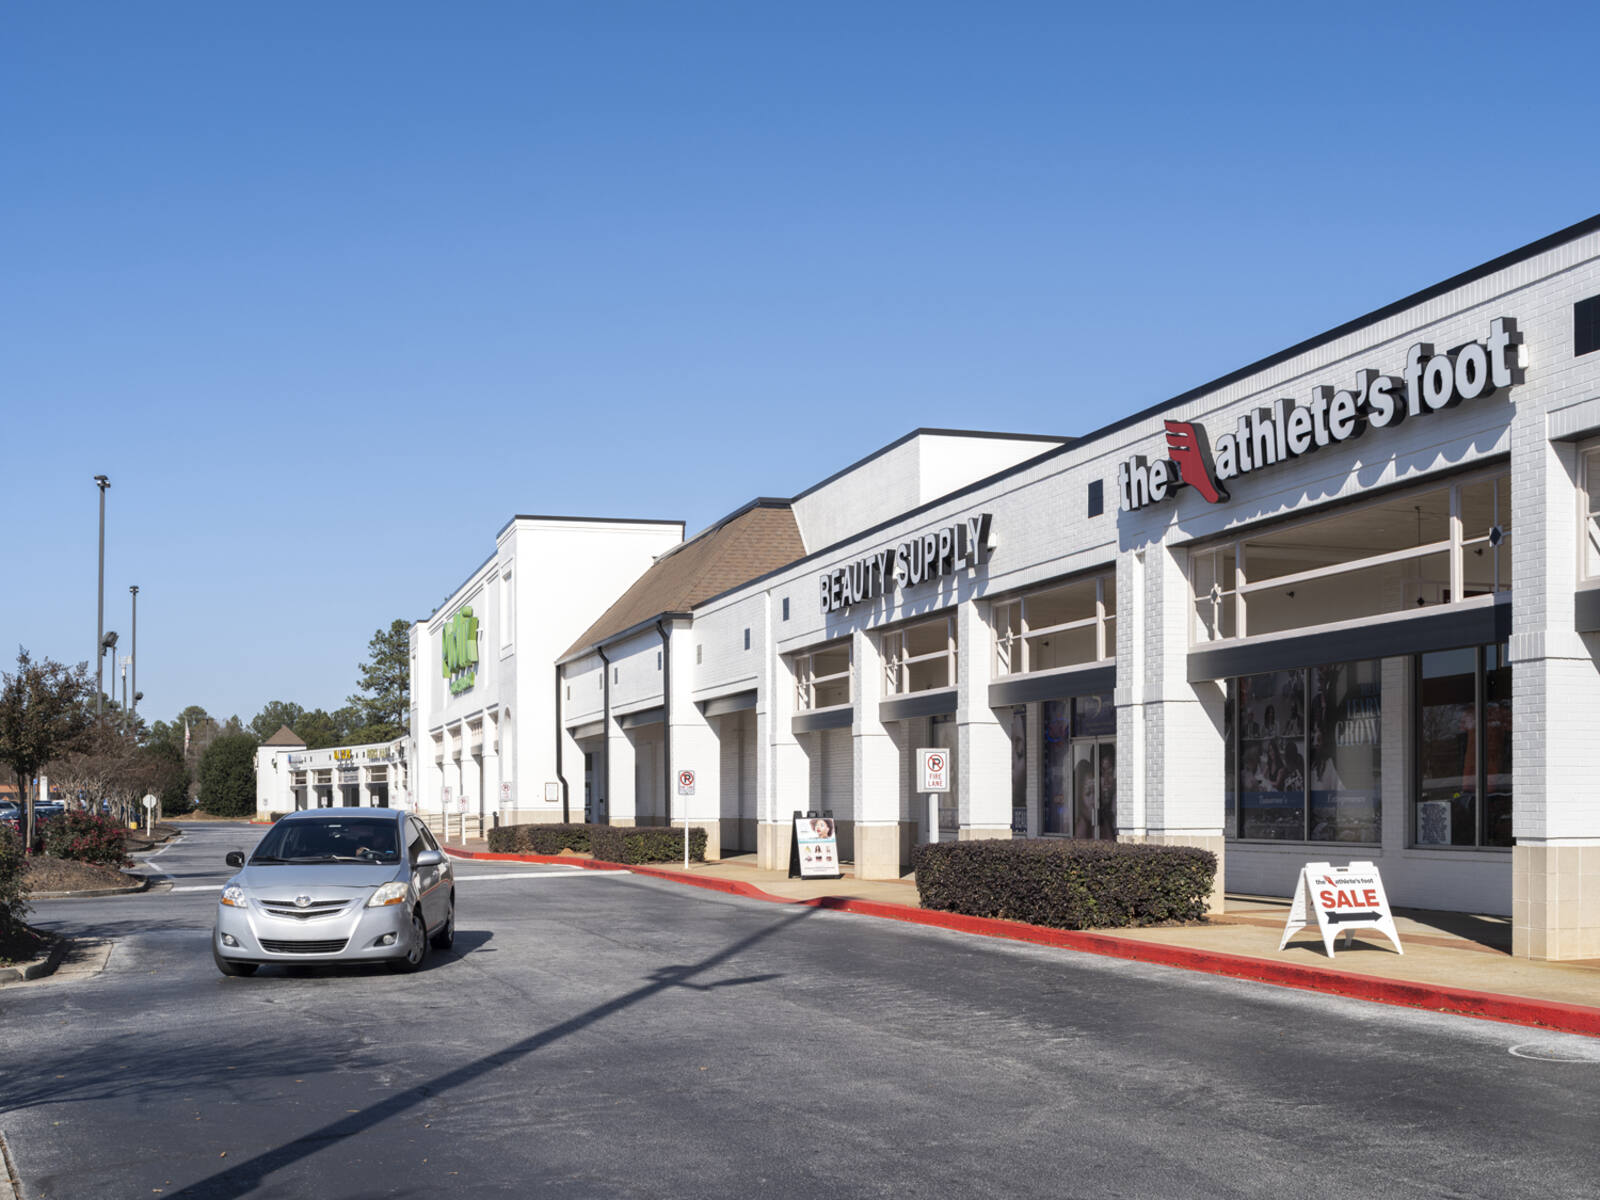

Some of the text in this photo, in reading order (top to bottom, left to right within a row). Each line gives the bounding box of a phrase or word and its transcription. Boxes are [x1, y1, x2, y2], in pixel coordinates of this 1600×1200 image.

[1118, 317, 1525, 511] the athlete's foot
[820, 513, 991, 614] BEAUTY SUPPLY
[1335, 719, 1380, 747] GROW
[1320, 889, 1380, 909] SALE
